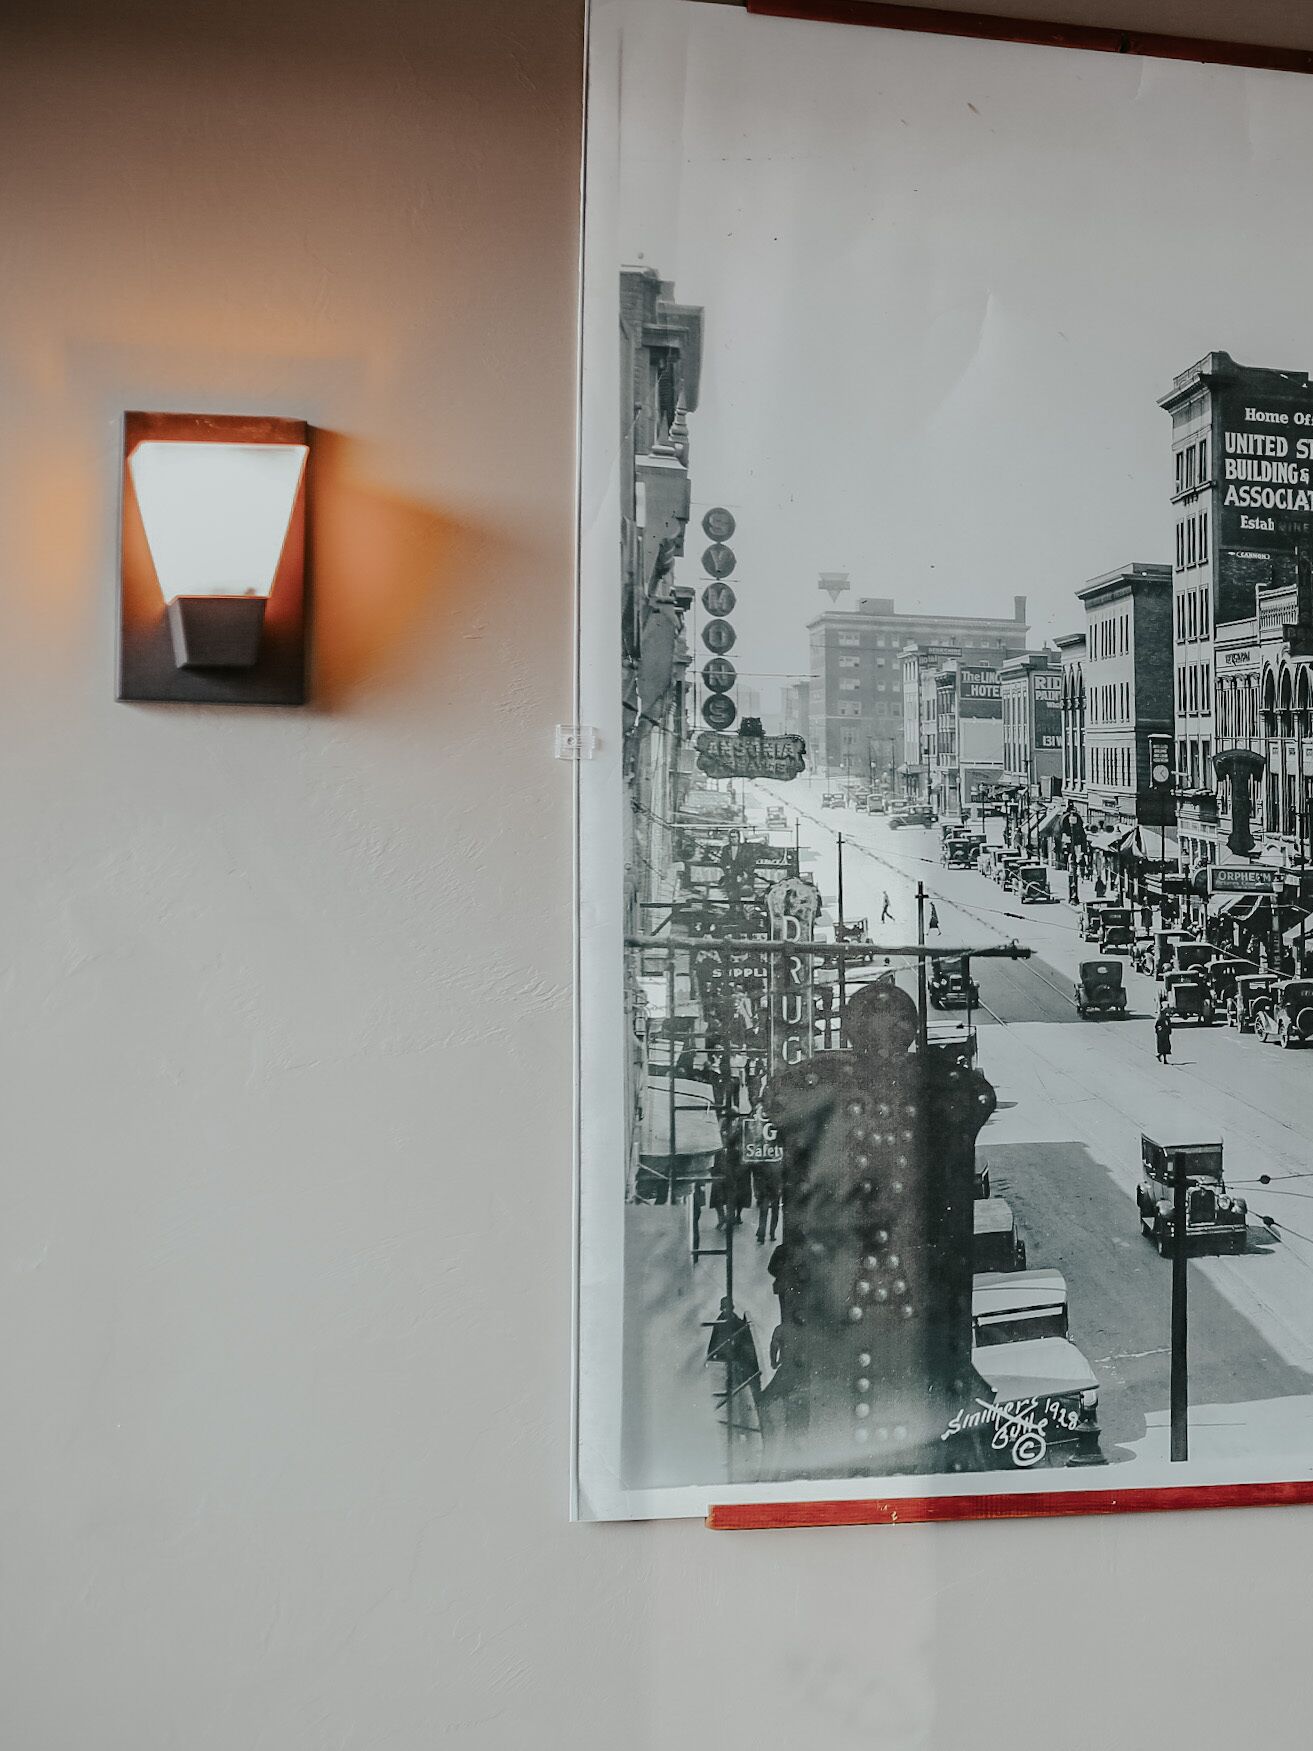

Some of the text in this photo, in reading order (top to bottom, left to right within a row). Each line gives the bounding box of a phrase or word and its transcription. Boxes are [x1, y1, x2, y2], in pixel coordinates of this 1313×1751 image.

[1244, 407, 1289, 424] Home
[1224, 431, 1289, 457] UNITED
[1224, 458, 1298, 485] BUILDING
[1299, 467, 1310, 485] &
[1240, 515, 1275, 531] Estab
[961, 670, 981, 683] The
[1034, 676, 1061, 690] RID
